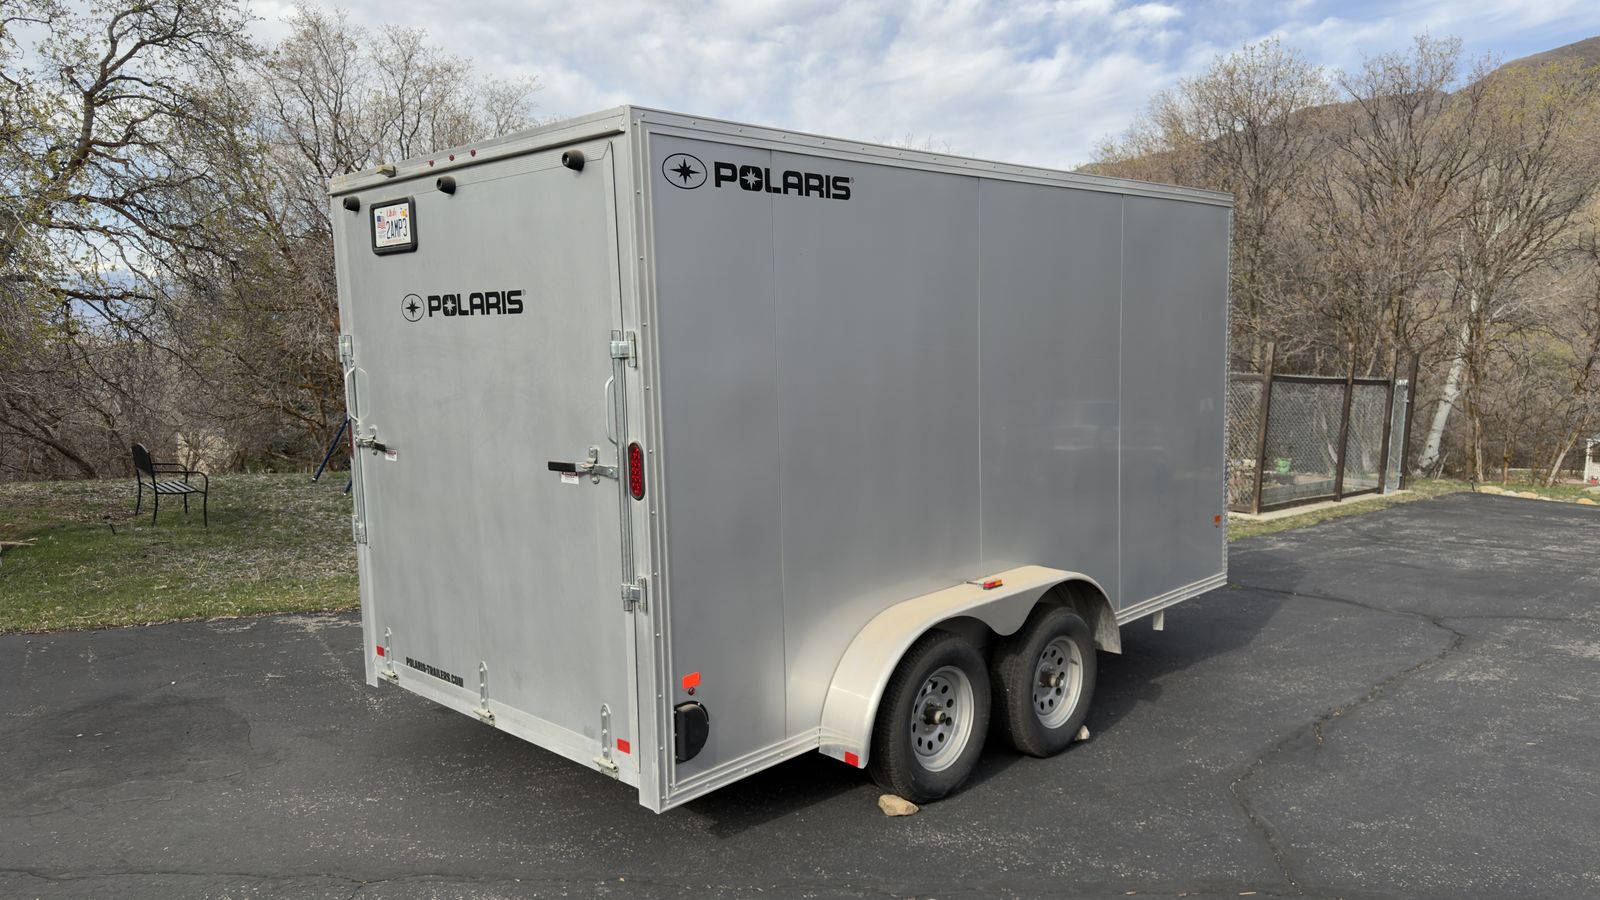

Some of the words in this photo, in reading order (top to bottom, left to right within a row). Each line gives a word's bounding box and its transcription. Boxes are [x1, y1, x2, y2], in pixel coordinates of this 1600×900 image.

[714, 161, 851, 201] POLARIS
[427, 290, 524, 317] POLARIS
[405, 656, 464, 688] POLARIS-TRAILERS.COM
